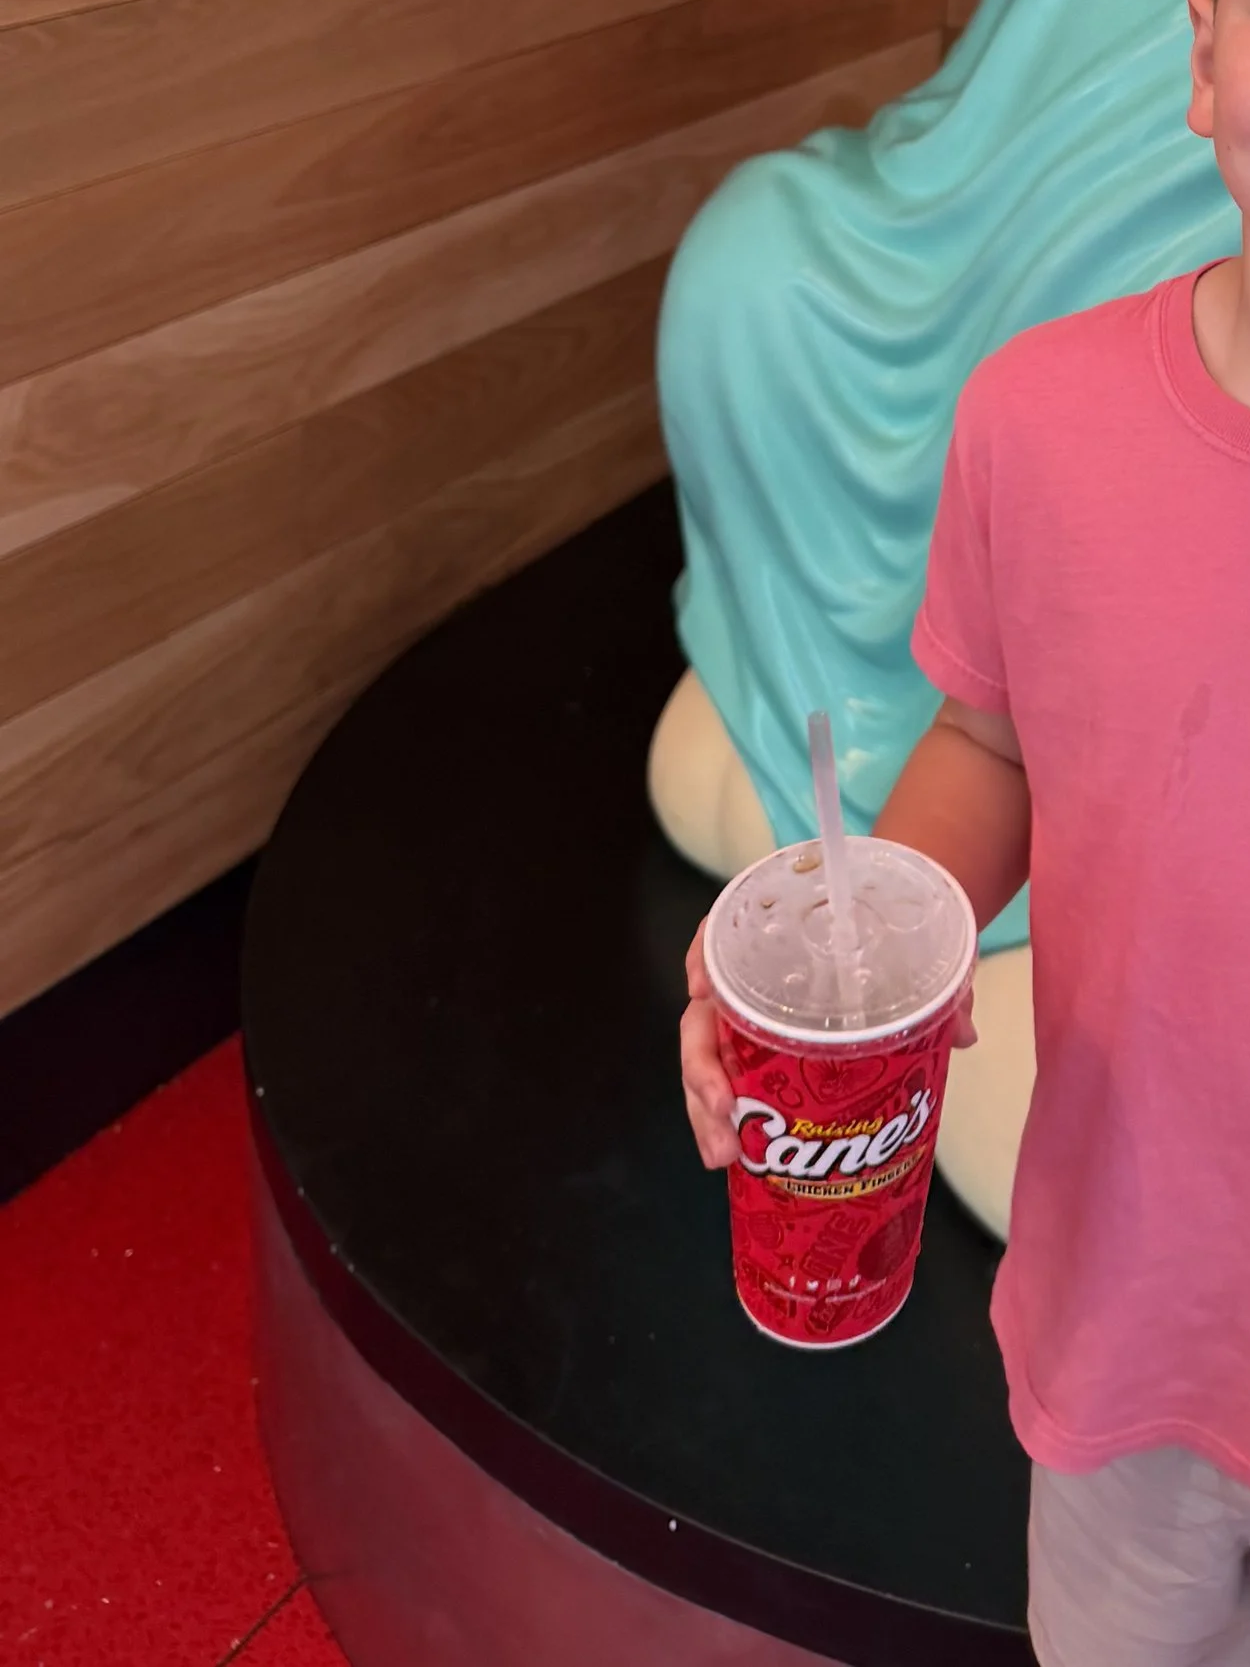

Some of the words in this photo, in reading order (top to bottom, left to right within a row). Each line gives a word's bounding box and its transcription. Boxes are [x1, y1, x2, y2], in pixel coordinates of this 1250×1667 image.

[730, 1087, 938, 1177] Cane's
[789, 1116, 885, 1138] Raising
[785, 1178, 856, 1196] CHICKEN
